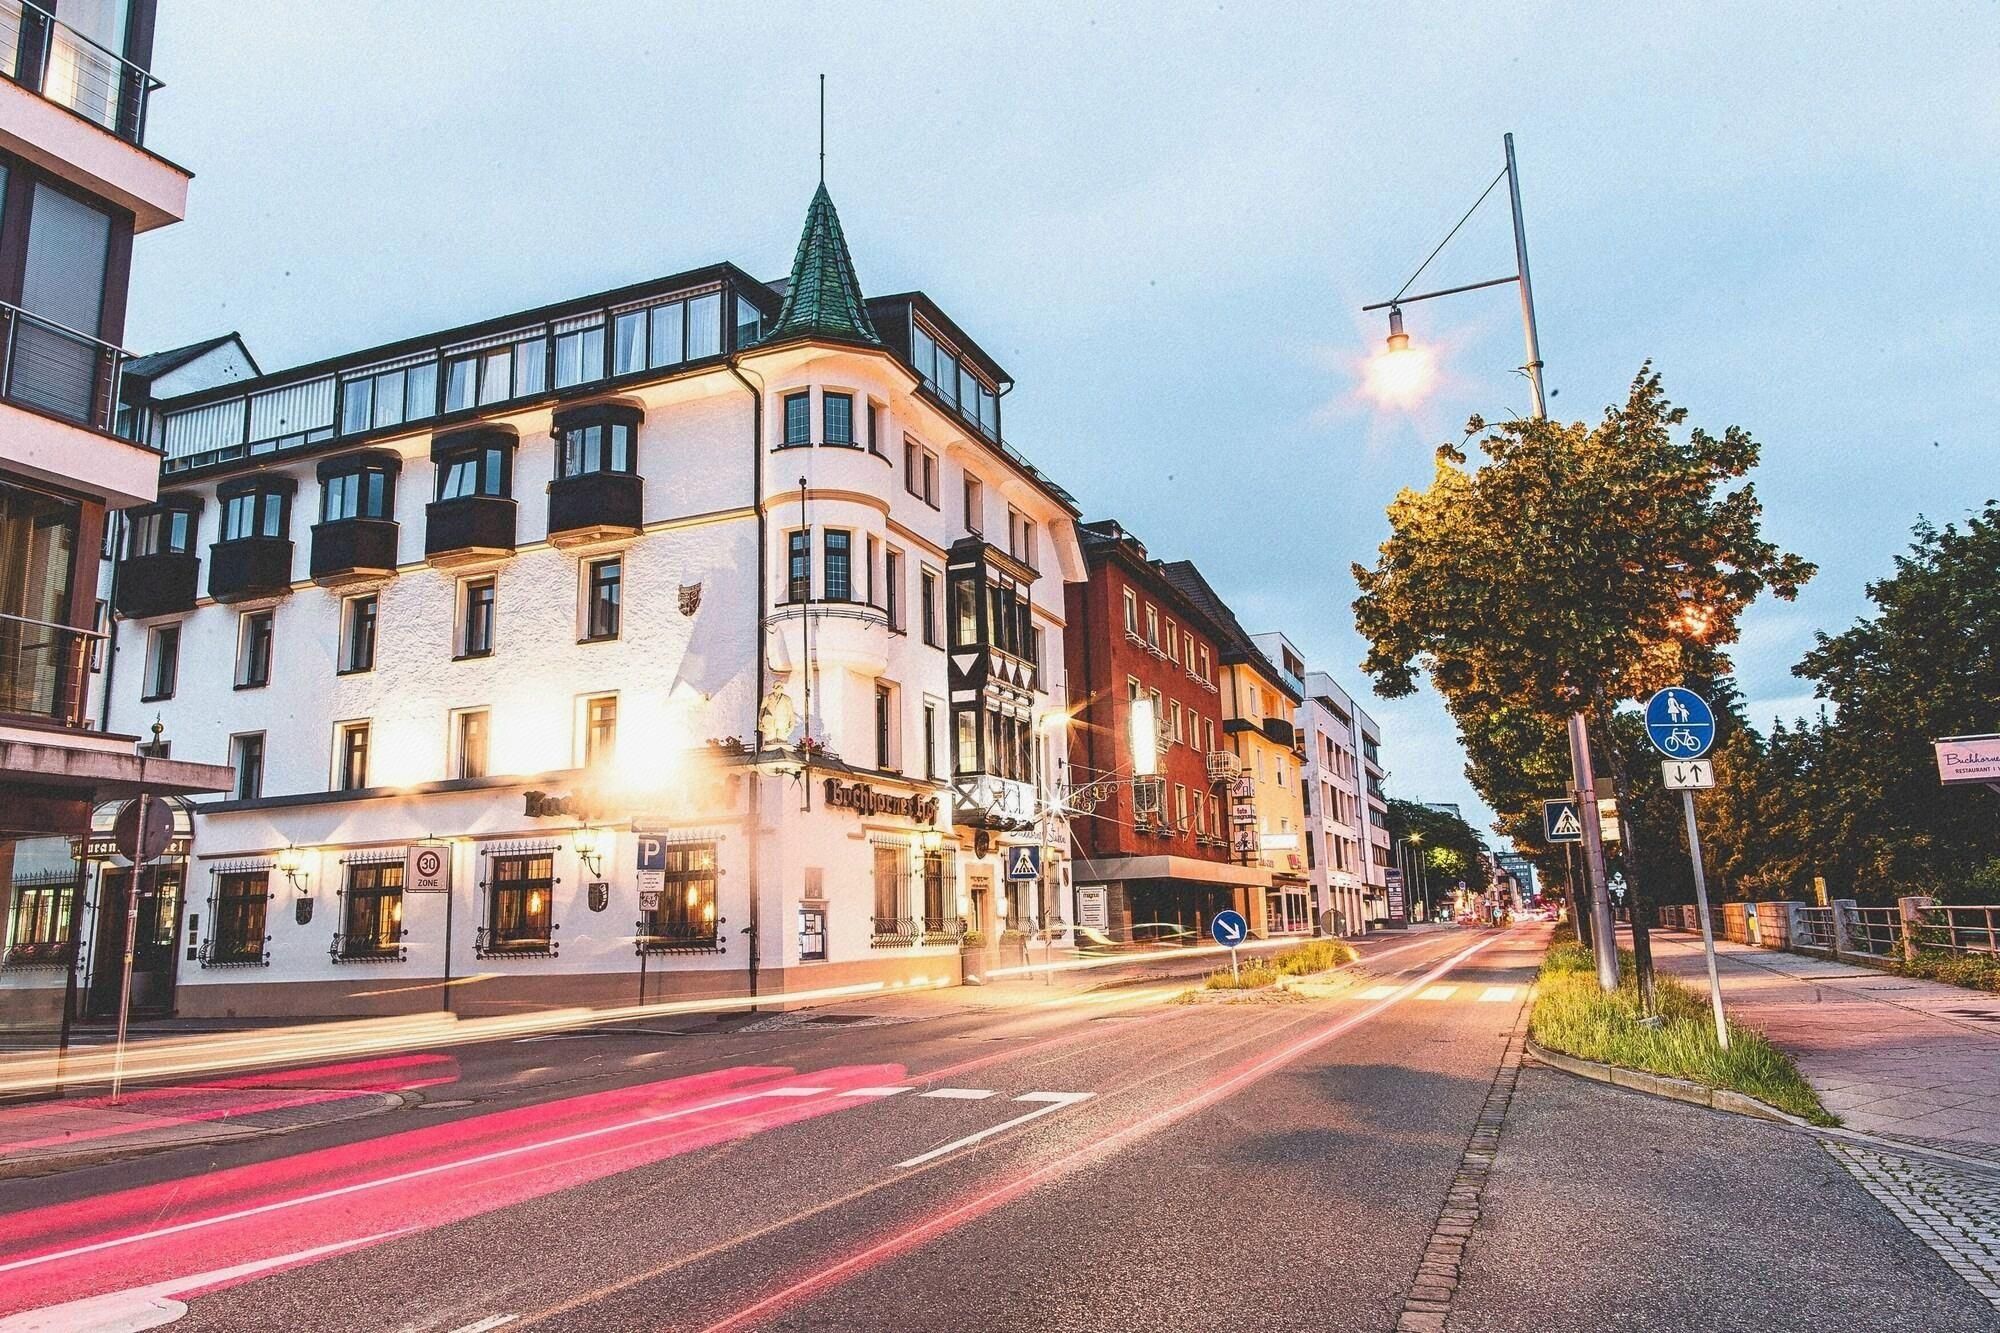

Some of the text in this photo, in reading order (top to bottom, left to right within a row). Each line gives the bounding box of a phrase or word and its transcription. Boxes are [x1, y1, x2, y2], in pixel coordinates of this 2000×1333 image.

[823, 778, 940, 826] Buchhorner Hof
[643, 839, 661, 866] P
[421, 857, 436, 870] 30
[417, 879, 439, 887] ZONE
